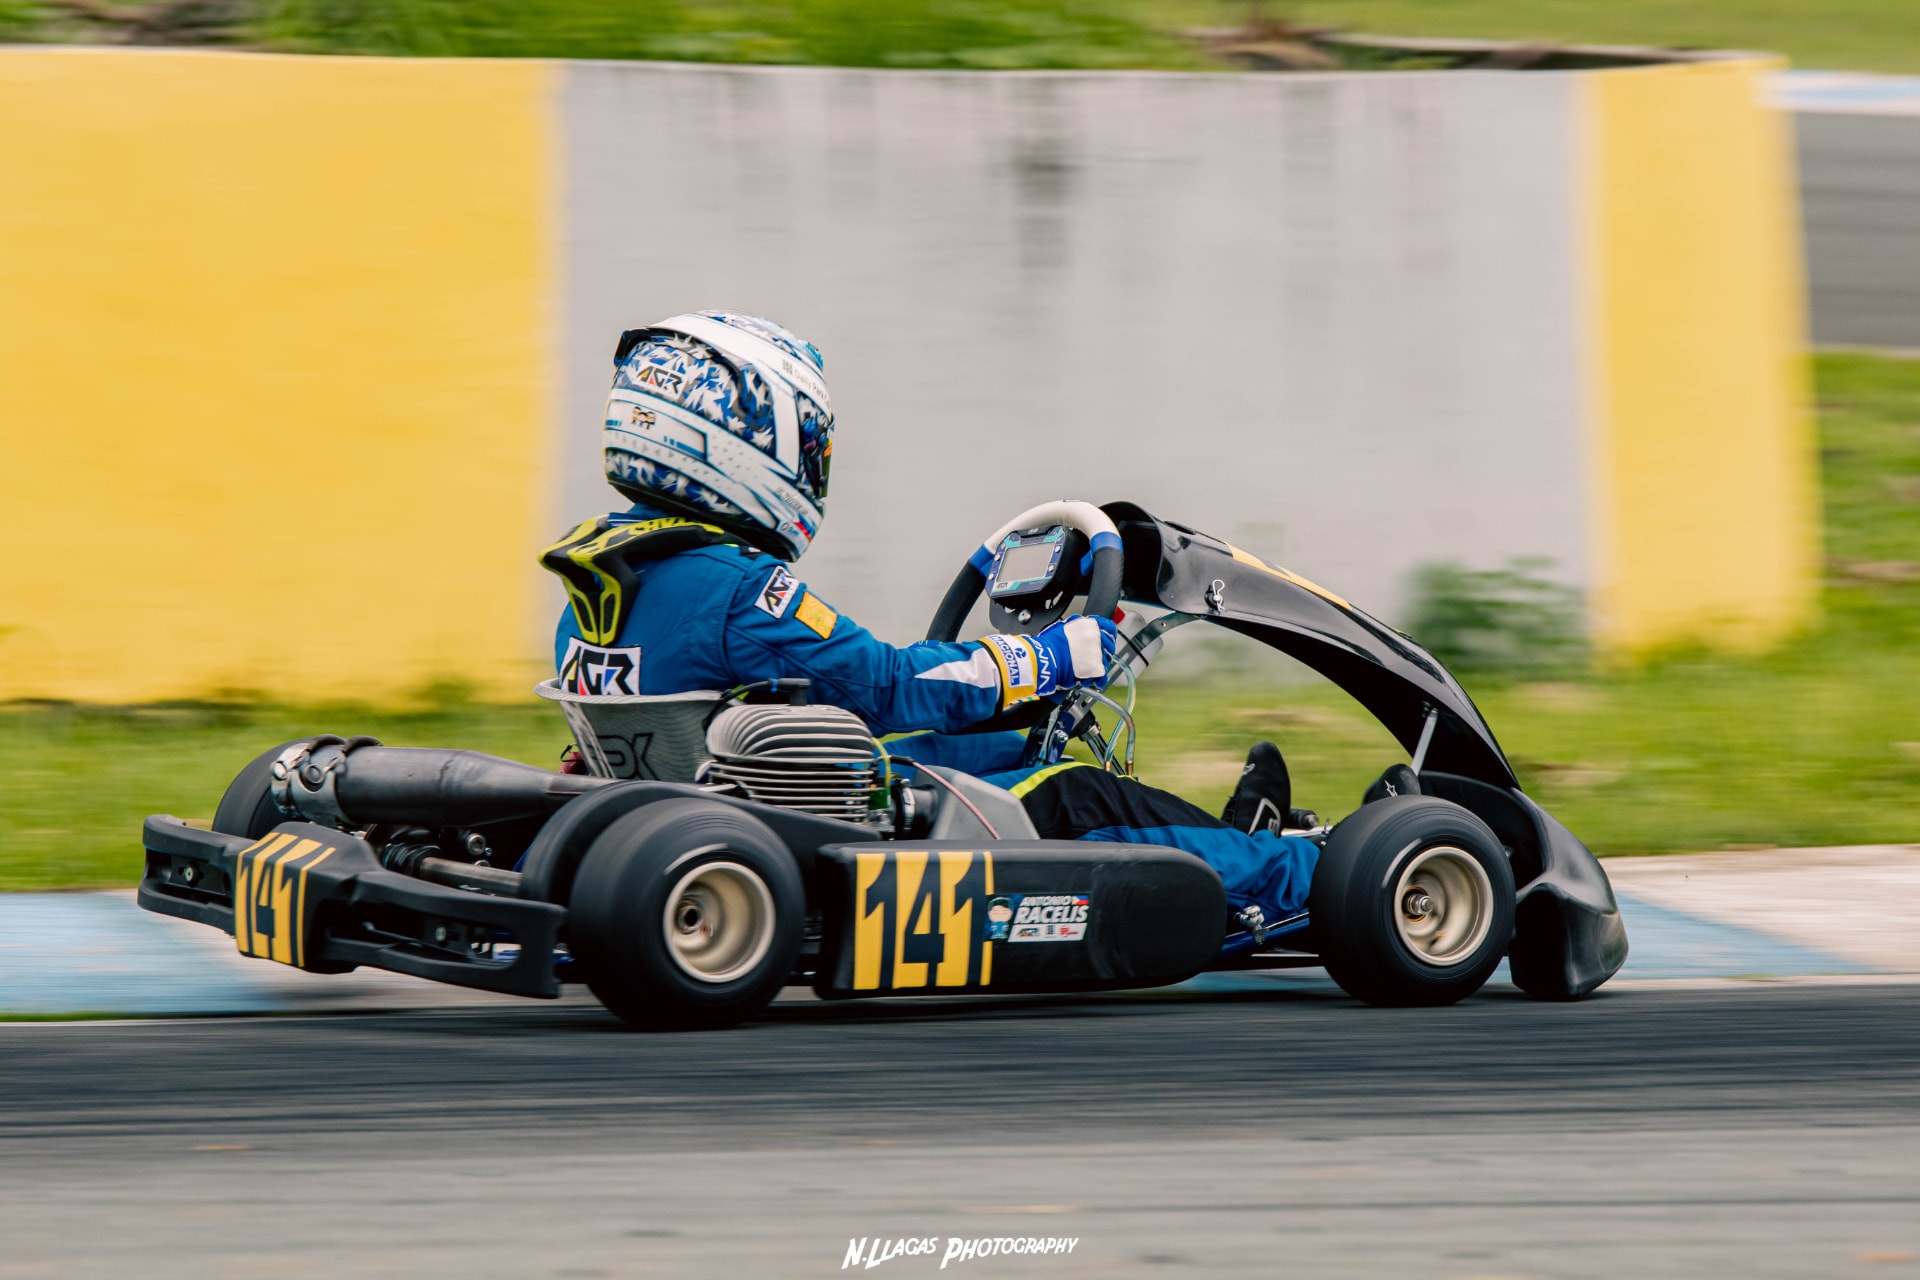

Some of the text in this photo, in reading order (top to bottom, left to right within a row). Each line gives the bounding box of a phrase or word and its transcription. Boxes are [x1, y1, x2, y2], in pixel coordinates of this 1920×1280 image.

[635, 365, 683, 394] AGR
[560, 645, 635, 696] AGR
[990, 635, 1019, 684] NACIONAL
[237, 832, 330, 967] 141
[863, 852, 987, 988] 141
[1013, 905, 1089, 924] RACELIS
[1019, 895, 1074, 907] ANTONIO
